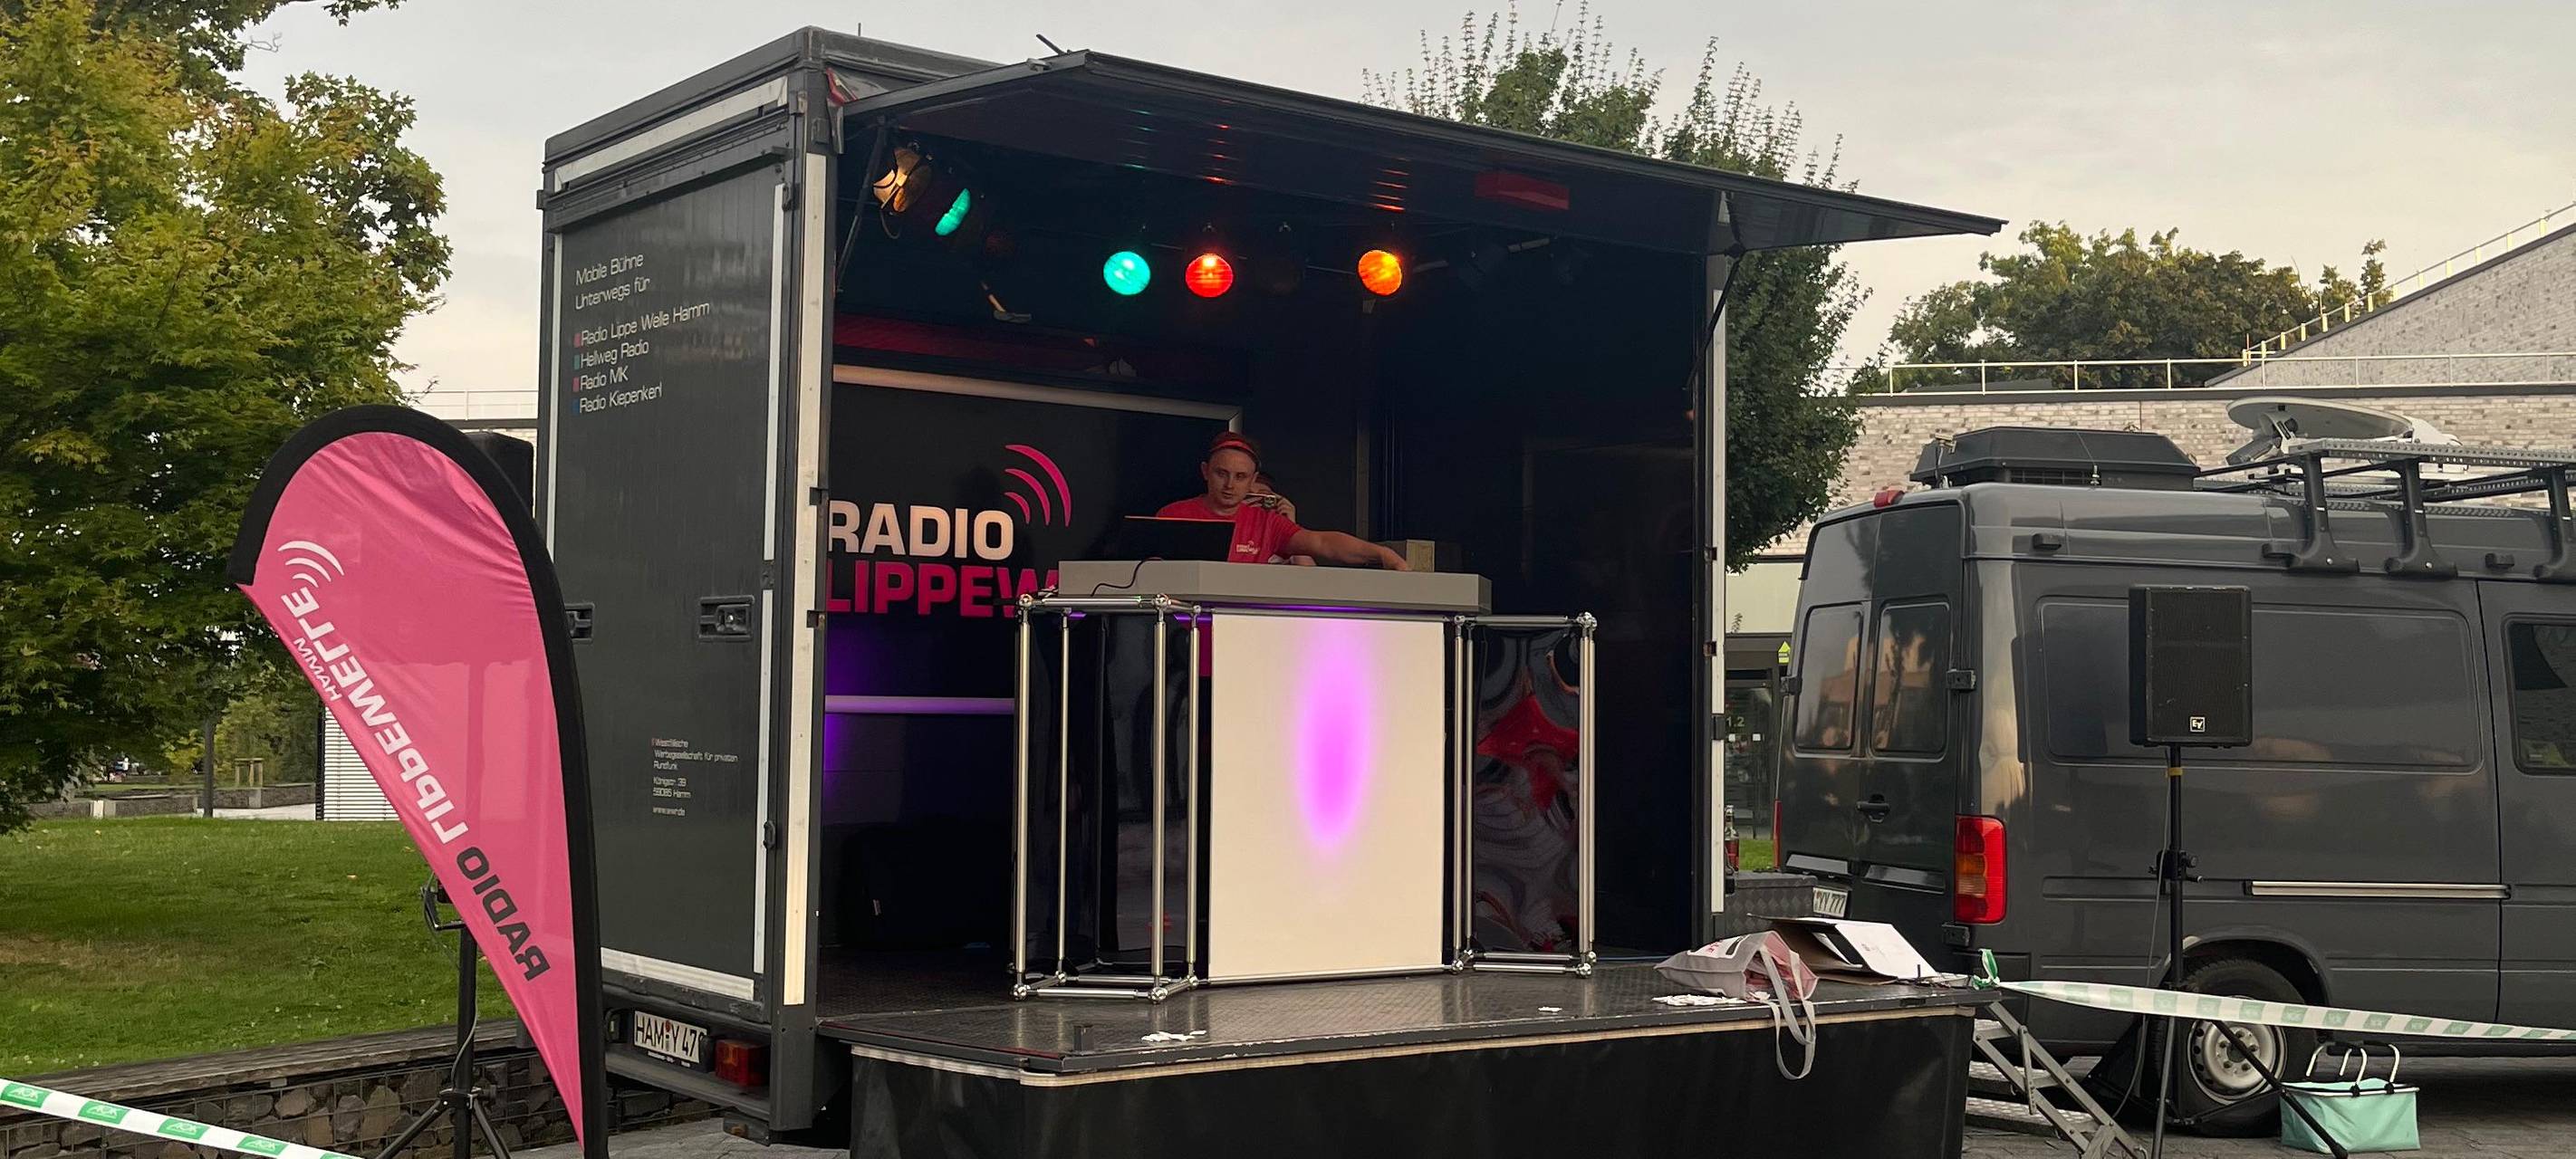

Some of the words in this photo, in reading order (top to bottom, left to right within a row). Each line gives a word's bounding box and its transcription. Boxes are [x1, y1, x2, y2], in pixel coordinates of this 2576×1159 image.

[575, 263, 608, 286] Mobile
[610, 254, 644, 276] Bühne
[575, 282, 630, 310] Unterwegs
[634, 276, 650, 293] für
[581, 327, 608, 347] Radio
[610, 320, 638, 340] Lippe
[641, 312, 669, 331] Welle
[673, 302, 710, 323] Hamm
[580, 347, 618, 369] Hellweg
[620, 340, 649, 359] Radio
[580, 372, 607, 391] Radio
[610, 366, 630, 384] MK
[580, 394, 606, 414] Radio
[609, 381, 662, 407] Kiepenkerl
[828, 500, 1014, 560] RADIO
[636, 1016, 664, 1049] HAM
[671, 1025, 679, 1052] Y
